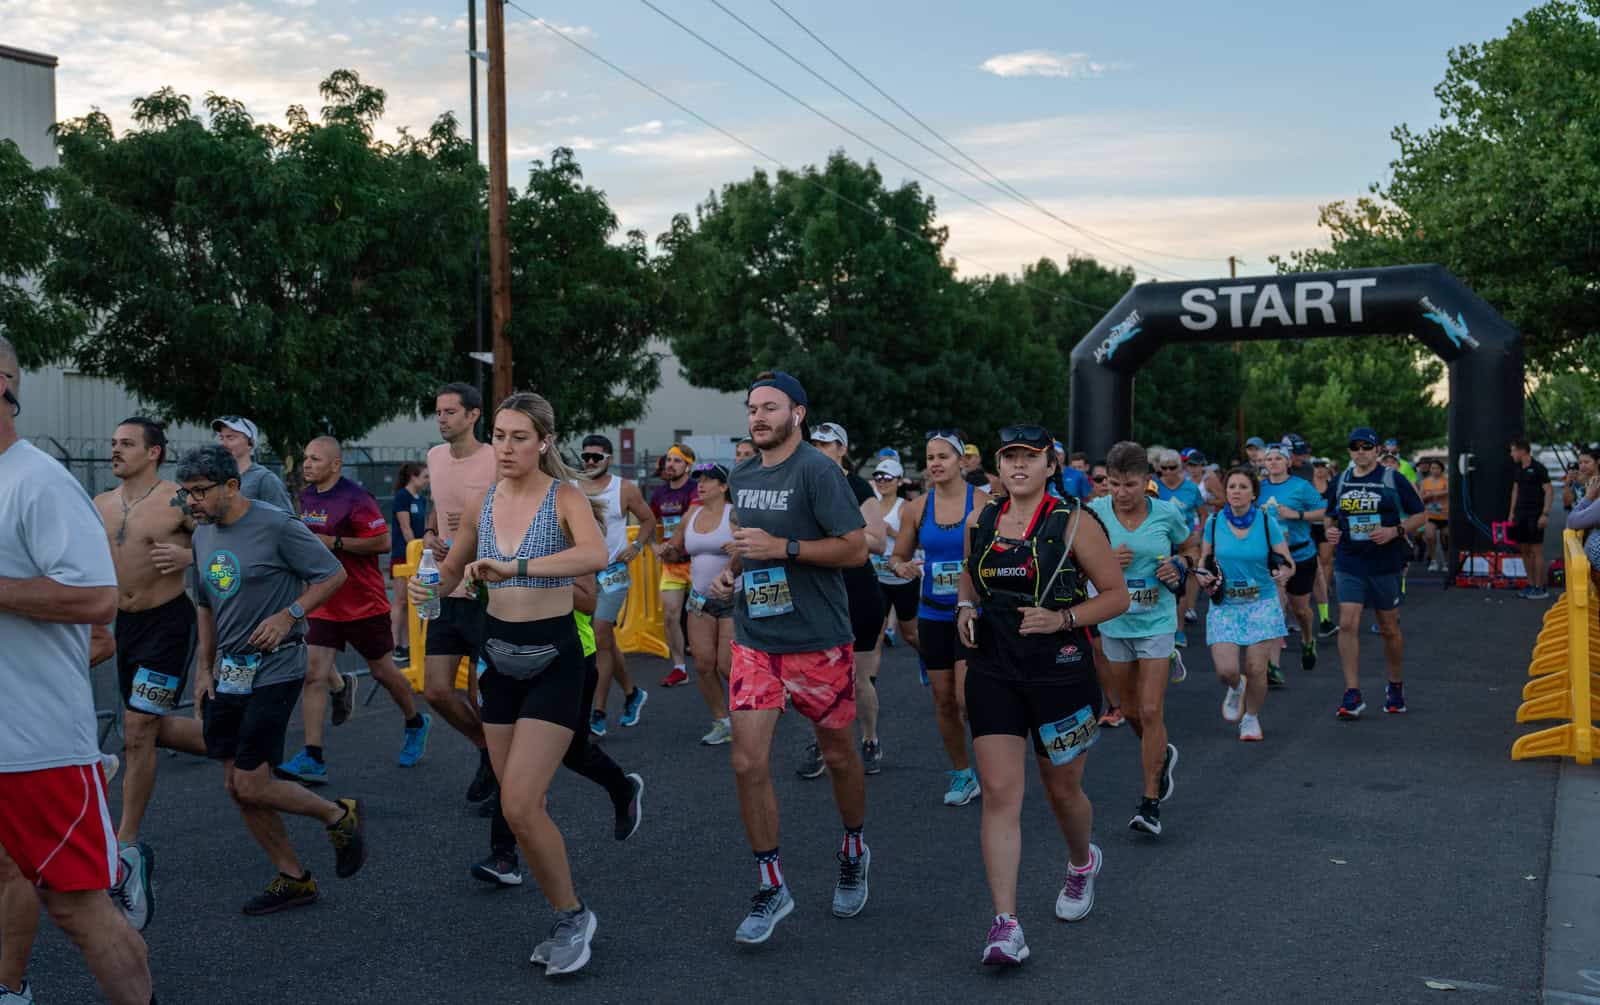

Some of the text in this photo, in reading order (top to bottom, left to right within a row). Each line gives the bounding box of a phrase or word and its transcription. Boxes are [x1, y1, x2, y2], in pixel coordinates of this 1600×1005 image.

[1179, 277, 1377, 331] START
[737, 488, 788, 511] THULE
[997, 567, 1026, 577] MEXICO
[749, 583, 780, 605] 257
[136, 682, 171, 703] 467
